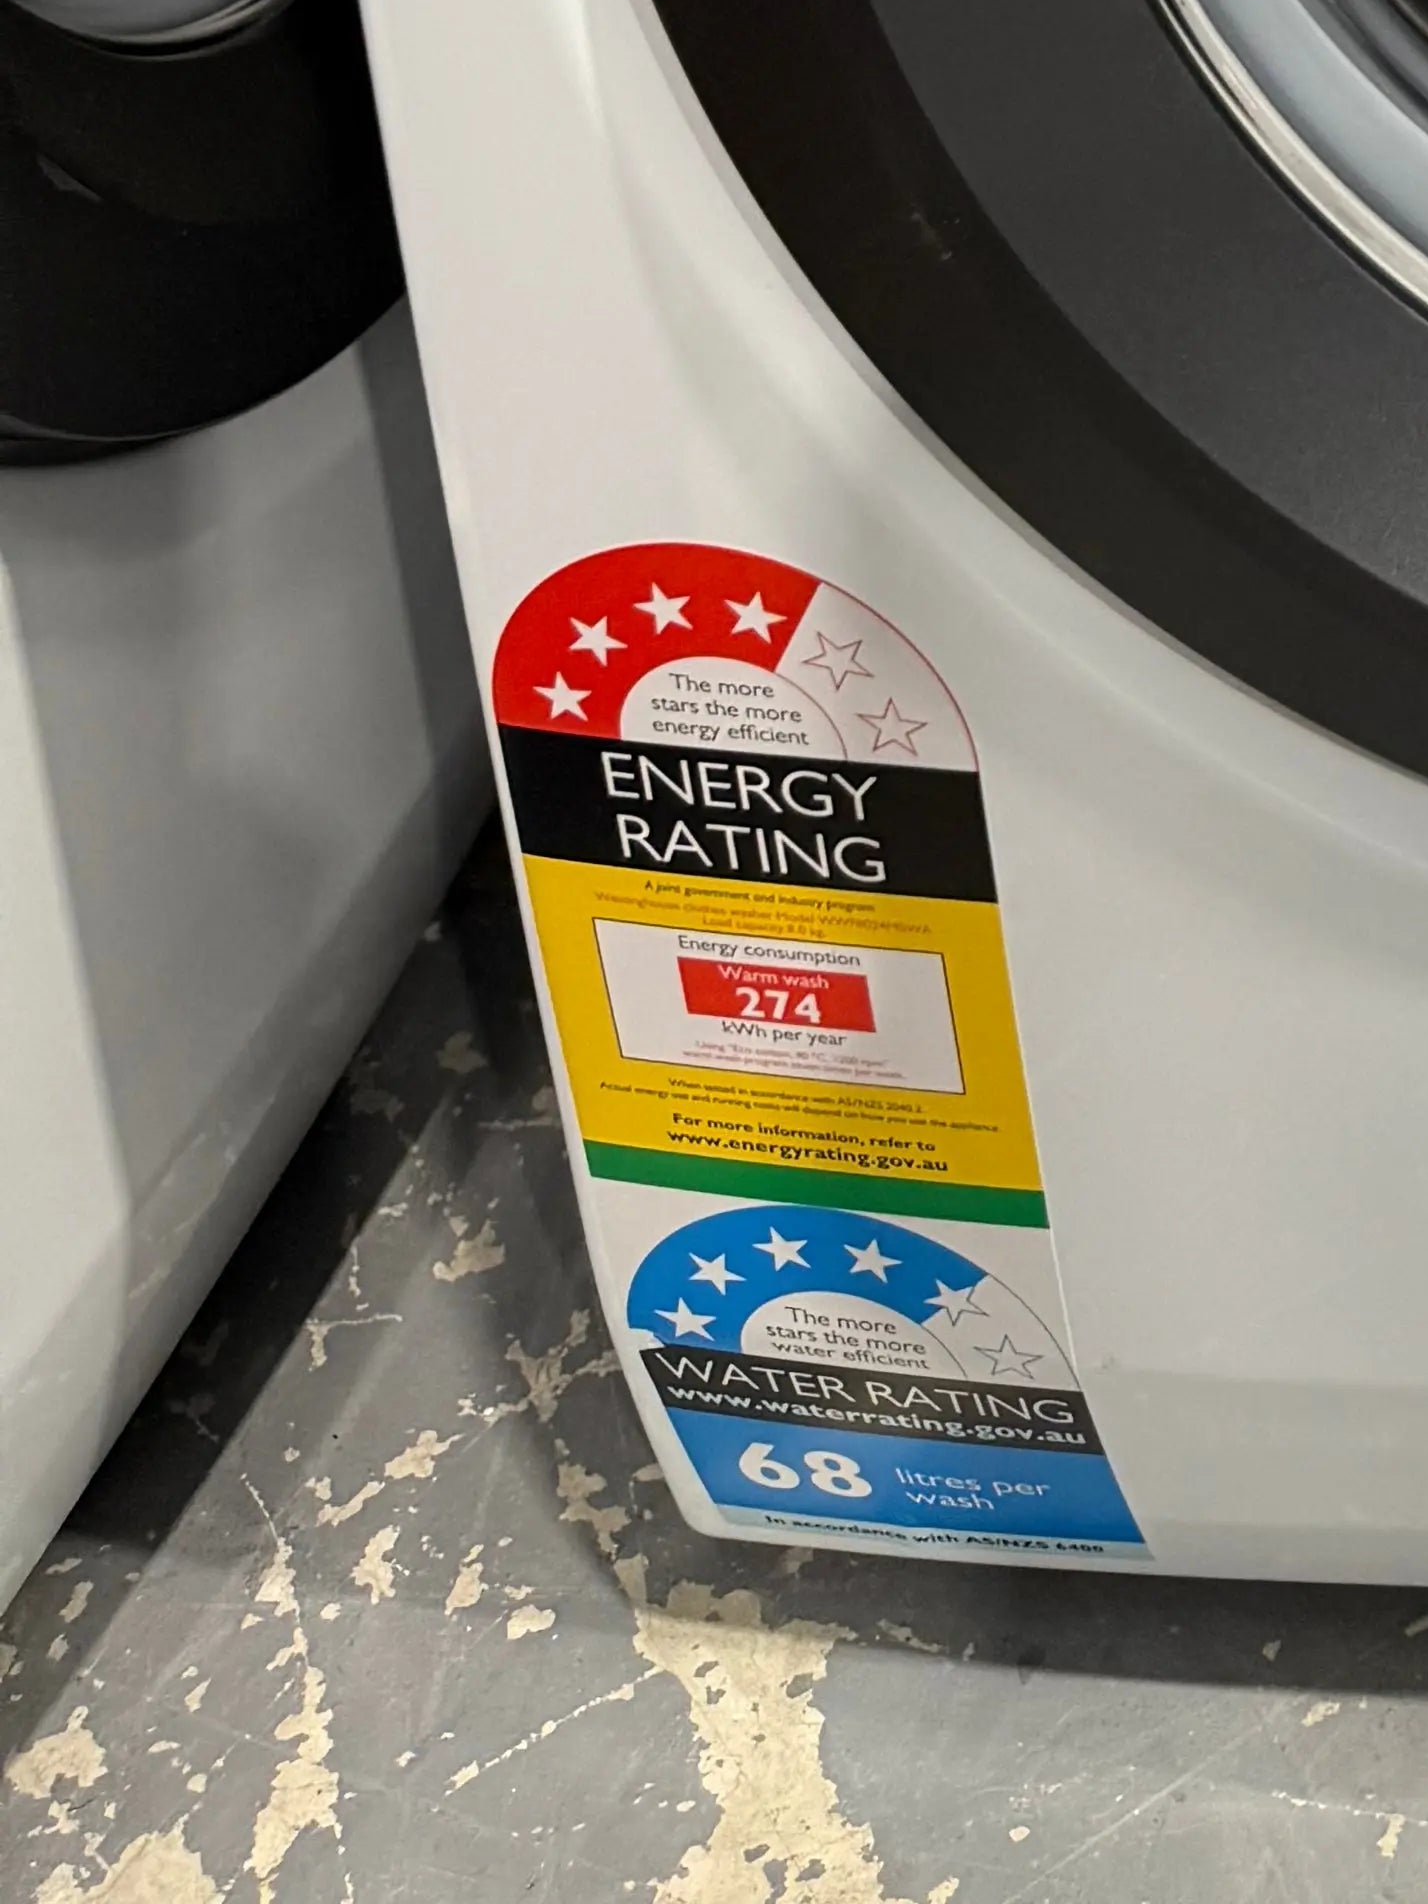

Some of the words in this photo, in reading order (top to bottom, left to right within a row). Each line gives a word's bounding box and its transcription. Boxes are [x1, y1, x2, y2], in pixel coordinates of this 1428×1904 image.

[669, 673, 712, 693] The
[718, 681, 775, 699] more
[651, 697, 699, 714] stars
[705, 700, 740, 718] the
[746, 707, 802, 723] more
[652, 719, 720, 742] energy
[727, 724, 810, 746] efficient
[600, 750, 877, 822] ENERGY
[615, 813, 888, 884] RATING
[677, 934, 738, 958] Energy
[744, 944, 861, 967] consumption
[717, 965, 779, 985] Warm
[783, 972, 830, 989] wash
[735, 986, 822, 1025] 274
[721, 1020, 768, 1039] kWh
[773, 1028, 802, 1042] per
[806, 1031, 848, 1047] year
[672, 1112, 703, 1127] For
[707, 1118, 754, 1133] more
[758, 1122, 865, 1147] information,
[869, 1136, 913, 1150] refer
[916, 1141, 936, 1152] to
[667, 1130, 949, 1172] www.energyrating.gov.au
[784, 1306, 830, 1327] The
[838, 1316, 897, 1335] more
[766, 1324, 818, 1343] stars
[823, 1330, 860, 1348] the
[866, 1338, 927, 1356] more
[772, 1342, 836, 1360] water
[843, 1348, 932, 1371] efficient
[655, 1352, 857, 1404] WATER
[865, 1378, 1075, 1425] RATING
[667, 1384, 1087, 1445] www.waterrating.gov.au
[737, 1441, 873, 1498] 68
[895, 1467, 982, 1491] litres
[991, 1480, 1051, 1496] per
[905, 1491, 995, 1511] wash
